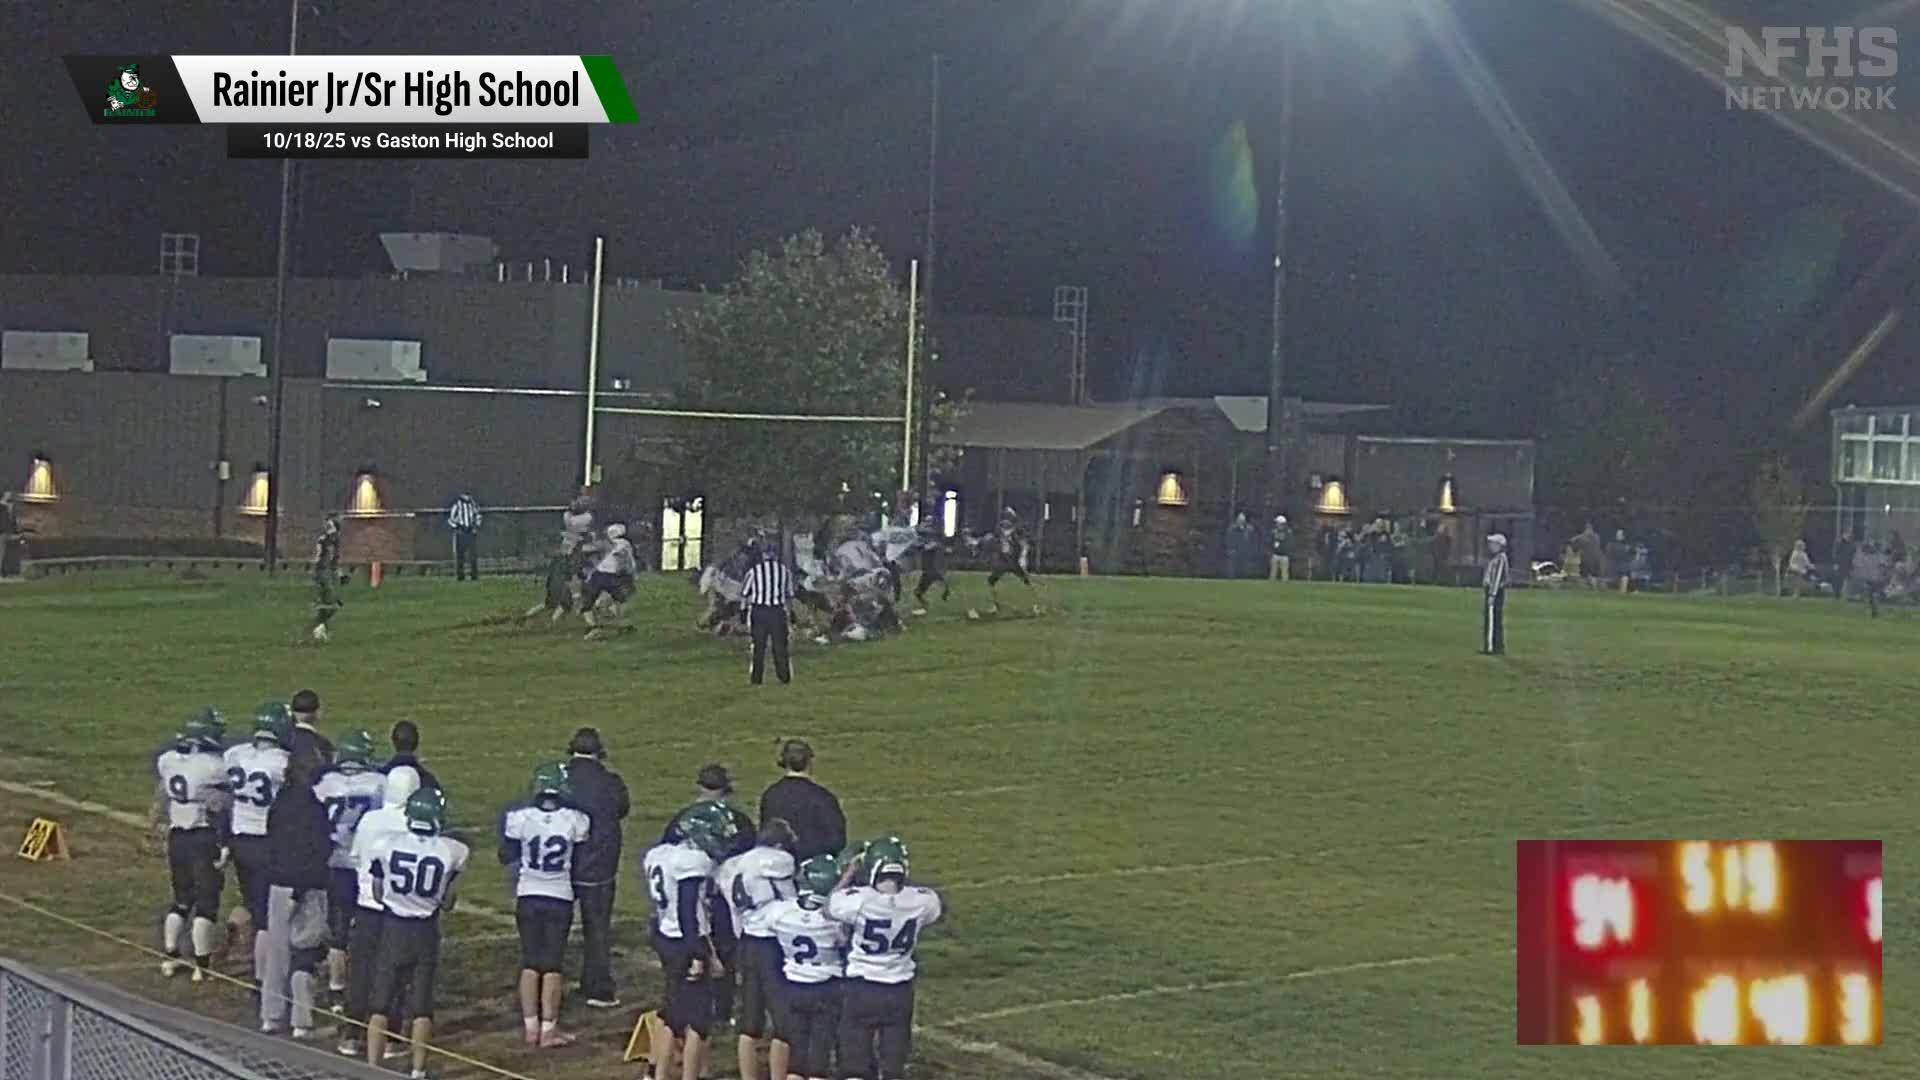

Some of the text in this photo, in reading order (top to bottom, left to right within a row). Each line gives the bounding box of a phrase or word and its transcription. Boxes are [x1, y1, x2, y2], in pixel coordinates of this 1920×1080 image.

[169, 774, 189, 804] 9
[227, 766, 273, 807] 23
[528, 834, 567, 872] 12
[389, 850, 445, 898] 50
[792, 935, 822, 965] 2
[861, 919, 918, 955] 54
